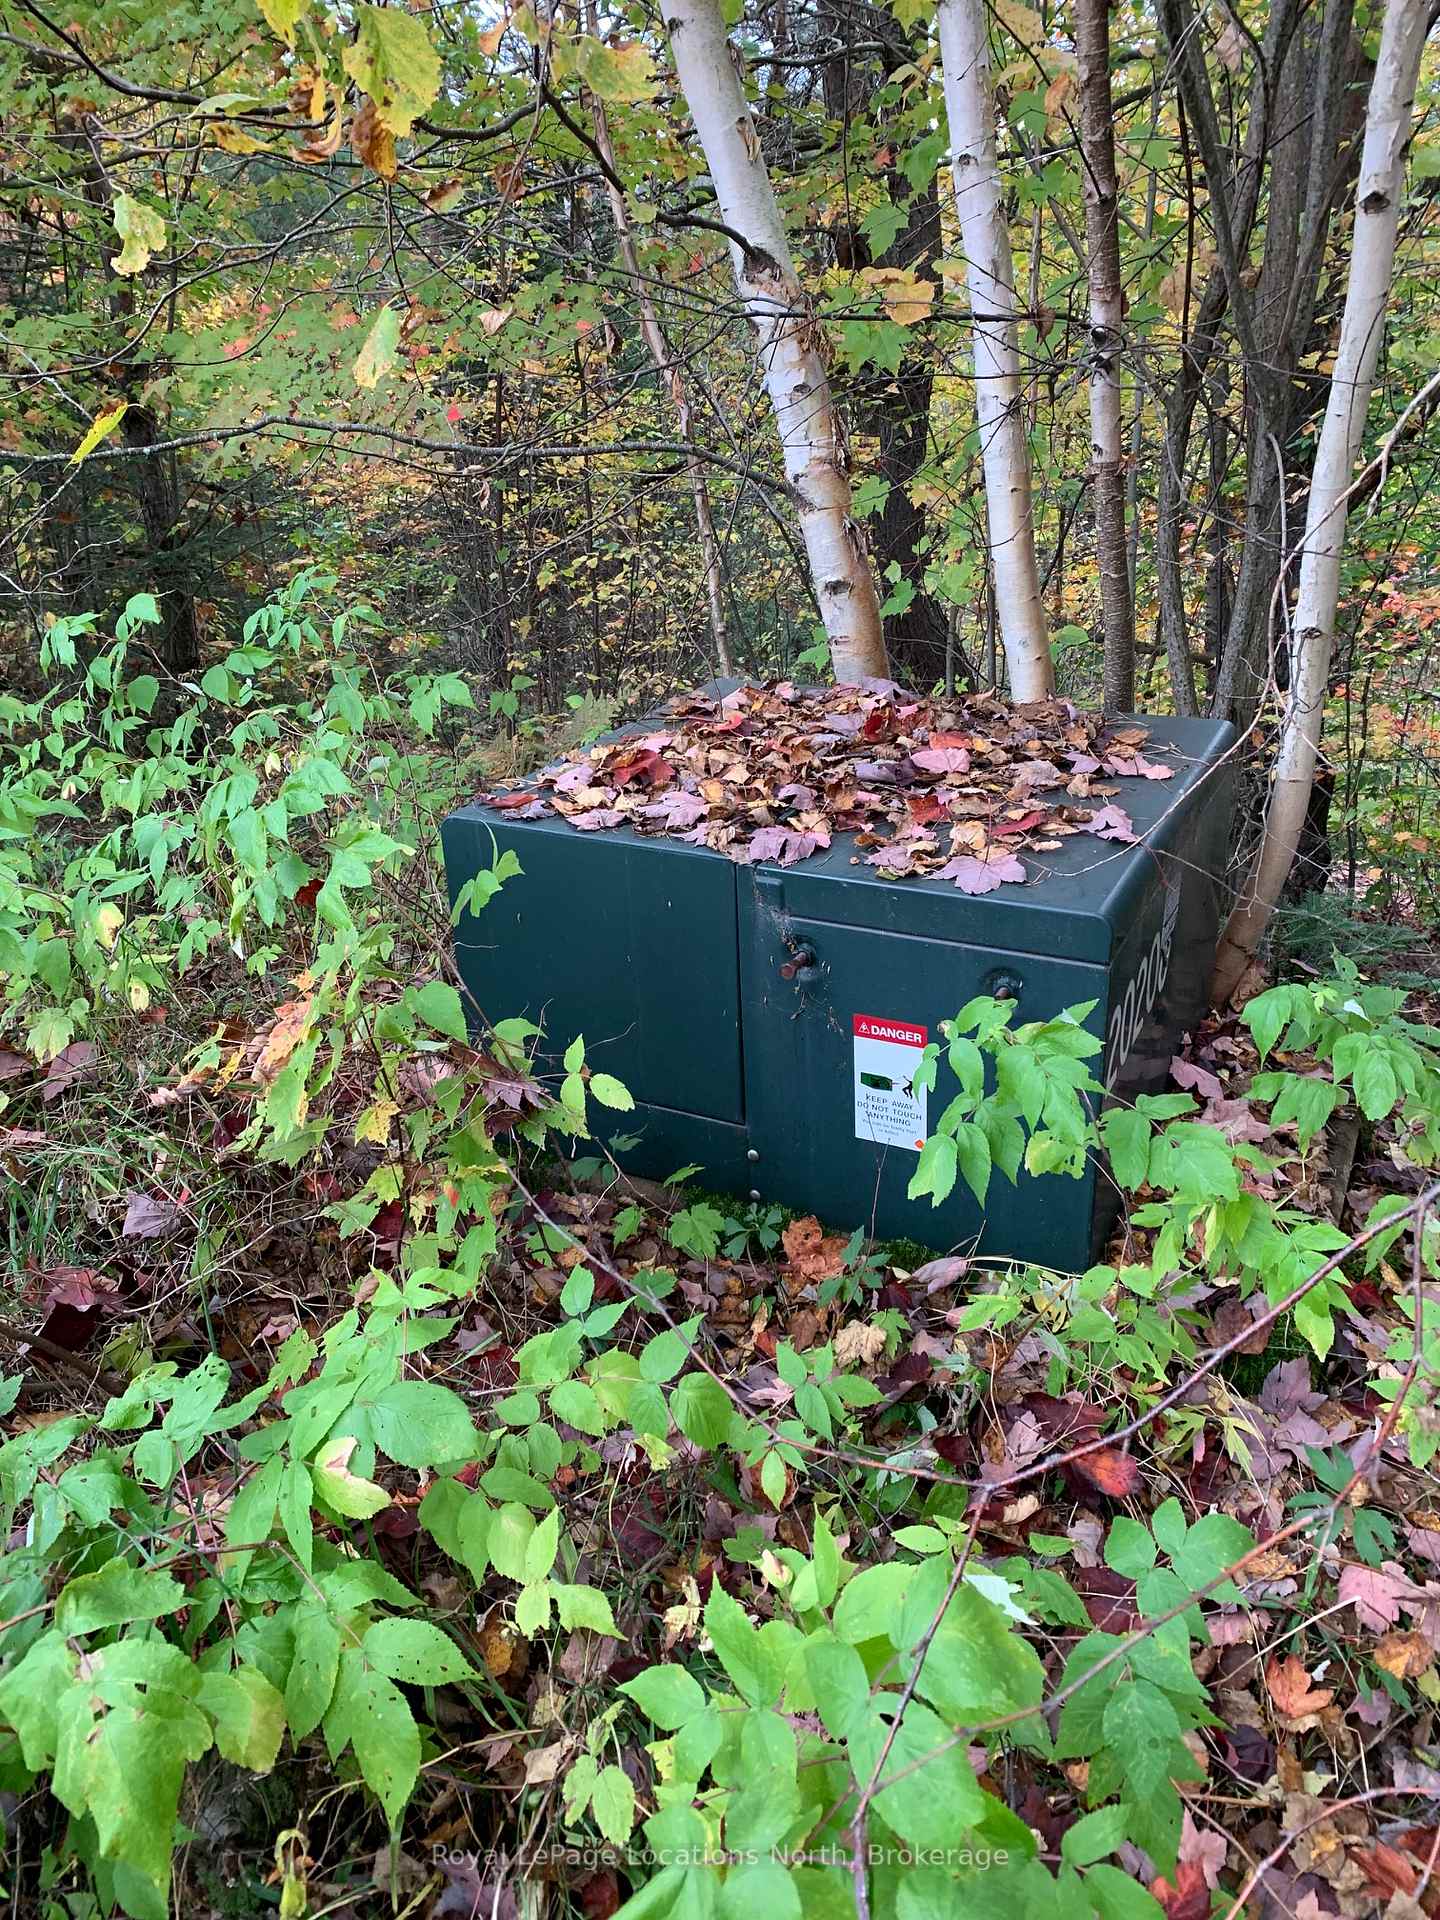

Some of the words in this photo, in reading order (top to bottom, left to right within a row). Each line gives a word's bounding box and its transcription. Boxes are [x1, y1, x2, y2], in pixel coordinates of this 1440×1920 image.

[871, 1025, 922, 1044] DANGER
[866, 1093, 888, 1104] KEEP
[892, 1100, 913, 1110] AWAY
[857, 1101, 869, 1109] DO
[872, 1104, 888, 1112] NOT
[893, 1109, 922, 1121] TOUCH
[867, 1111, 911, 1127] ANYTHING
